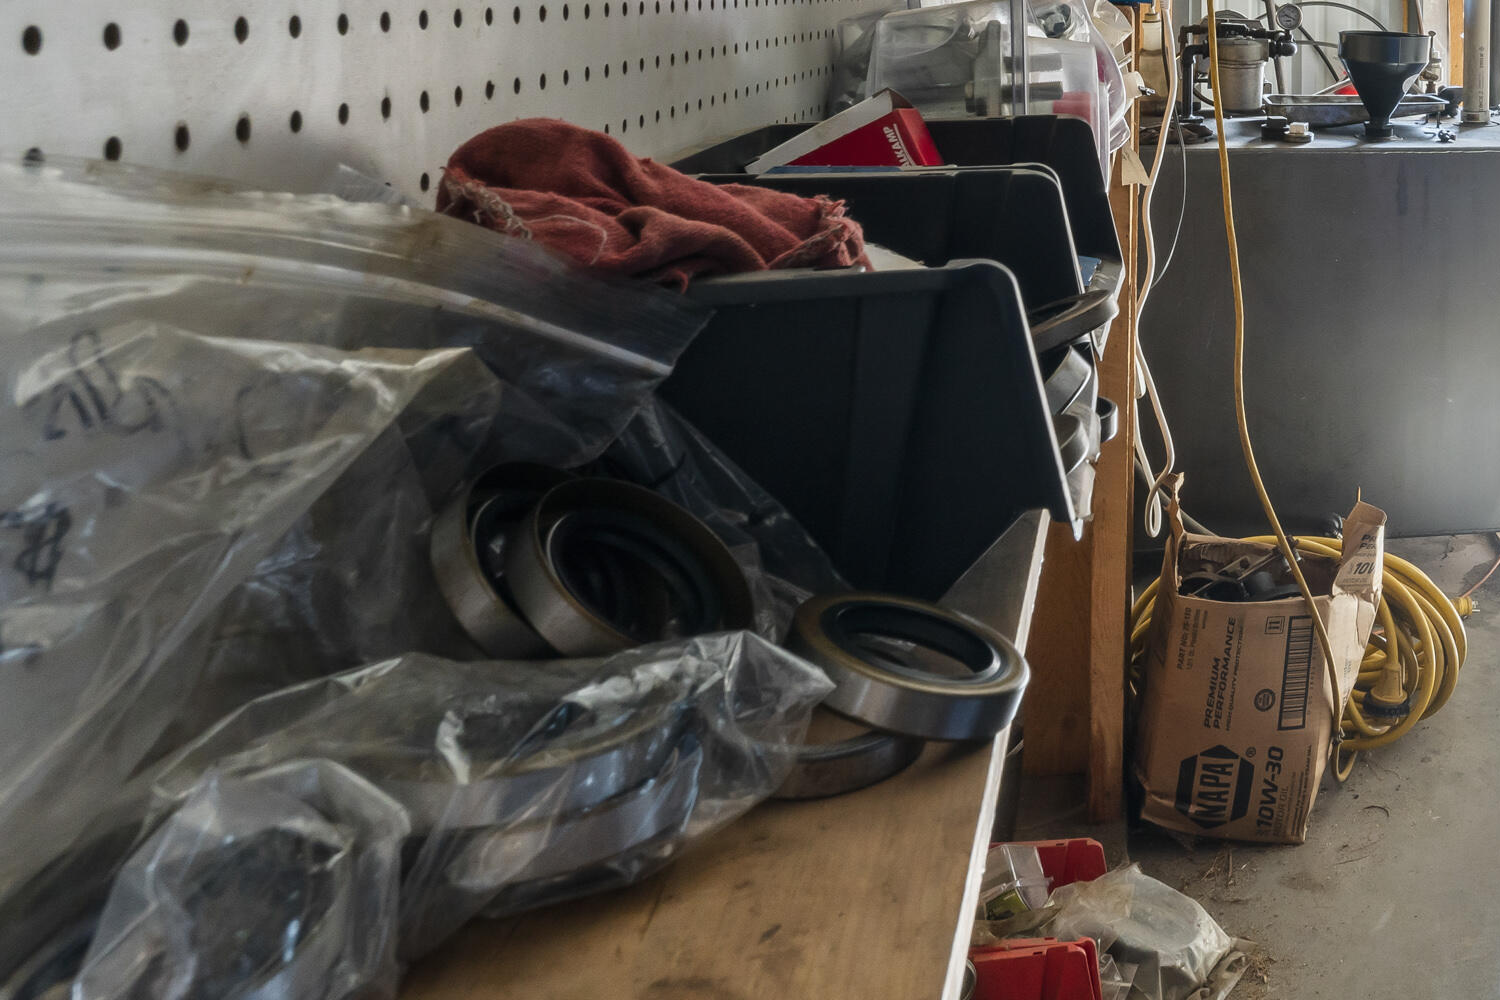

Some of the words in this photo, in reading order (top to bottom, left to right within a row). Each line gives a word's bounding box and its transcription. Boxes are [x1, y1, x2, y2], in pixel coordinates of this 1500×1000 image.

[1203, 656, 1221, 729] PREMIUM
[1212, 615, 1236, 730] PERFORMANCE
[1228, 676, 1236, 711] QUALITY
[1198, 758, 1234, 827] NAPA
[1256, 745, 1284, 828] 10W-30
